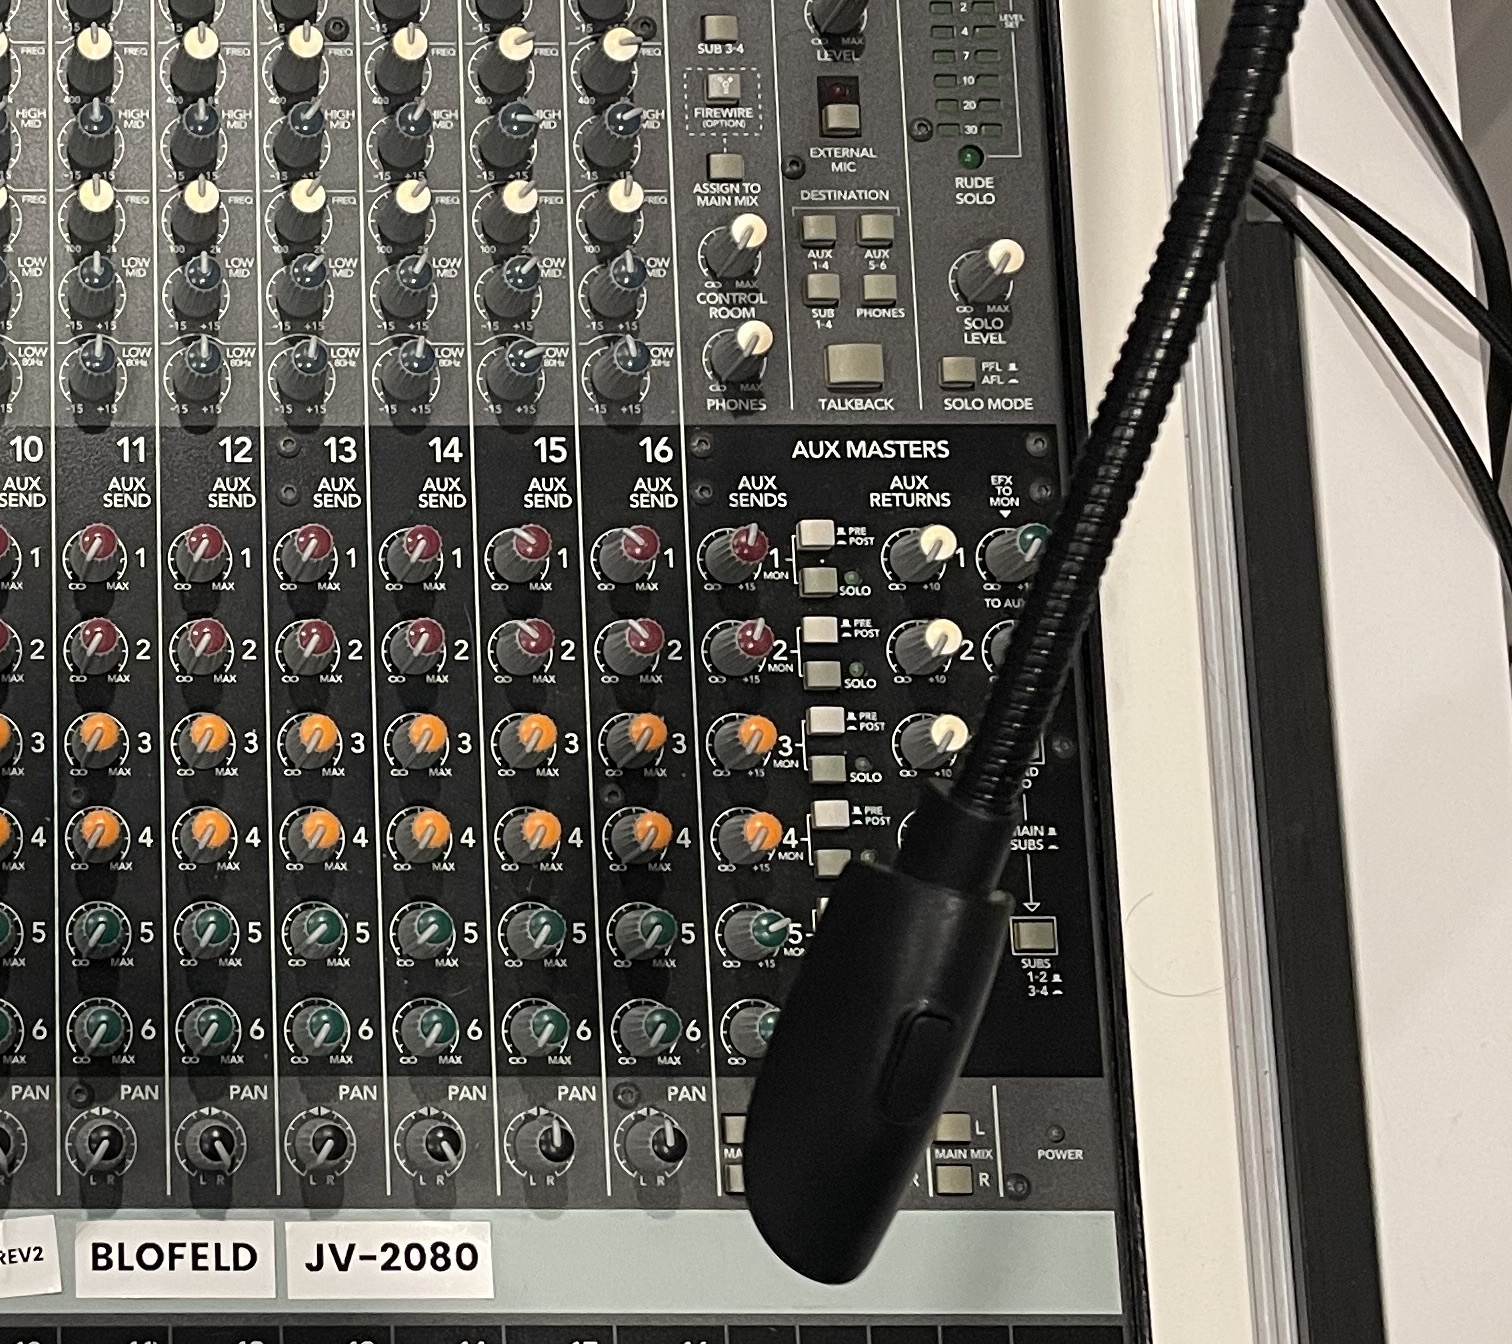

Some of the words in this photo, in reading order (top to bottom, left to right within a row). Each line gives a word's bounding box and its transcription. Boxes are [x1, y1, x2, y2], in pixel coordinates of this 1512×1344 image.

[698, 43, 722, 54] SUB
[726, 44, 744, 54] 3-4
[817, 49, 860, 61] LEVEL
[695, 108, 753, 118] FIREWIRE
[703, 120, 745, 128] (OPTION)
[810, 147, 877, 158] EXTERNAL
[832, 162, 856, 172] MIC
[955, 177, 994, 188] RUDE
[693, 183, 739, 194] ASSIGN
[742, 183, 761, 193] TO
[801, 190, 889, 200] DESTINATION
[956, 193, 995, 204] SOLO
[697, 196, 731, 206] MAIN
[735, 196, 758, 206] MIX
[808, 249, 832, 259] AUX
[865, 249, 889, 258] AUX
[813, 261, 829, 270] 1-4
[869, 260, 886, 270] 5-6
[697, 292, 767, 304] CONTROL
[709, 307, 755, 318] ROOM
[812, 309, 834, 318] SUB
[857, 308, 905, 318] PHONES
[816, 320, 832, 328] 1-4
[964, 317, 1003, 330] SOLO
[964, 333, 1006, 344] LEVEL
[982, 362, 1002, 371] PFL
[982, 375, 1004, 384] AFL
[707, 399, 766, 411] PHONES
[818, 398, 894, 410] TALKBACK
[944, 398, 981, 410] SOLO
[985, 398, 1033, 410] MODE
[10, 436, 43, 462] 10
[792, 441, 840, 458] AUX
[847, 440, 949, 458] MASTERS
[3, 476, 41, 491] AUX
[738, 476, 777, 490] AUX
[890, 475, 929, 490] AUX
[991, 475, 1012, 485] EFX
[995, 486, 1012, 496] TO
[729, 493, 787, 507] SENDS
[870, 493, 950, 507] RETURNS
[990, 495, 1019, 506] MON
[849, 527, 866, 535] PRE
[849, 537, 874, 545] POST
[837, 586, 871, 596] SOLO
[1010, 839, 1044, 850] SUBS
[1021, 959, 1051, 968] SUBS
[1027, 971, 1048, 982] 1-2
[1029, 985, 1048, 996] 3-4
[339, 1085, 376, 1100] PAN
[935, 1149, 967, 1159] MAIN
[971, 1149, 993, 1159] MIX
[1038, 1149, 1083, 1160] POWER
[92, 1243, 257, 1271] BLOFELD
[305, 1242, 478, 1271] JV-2080
